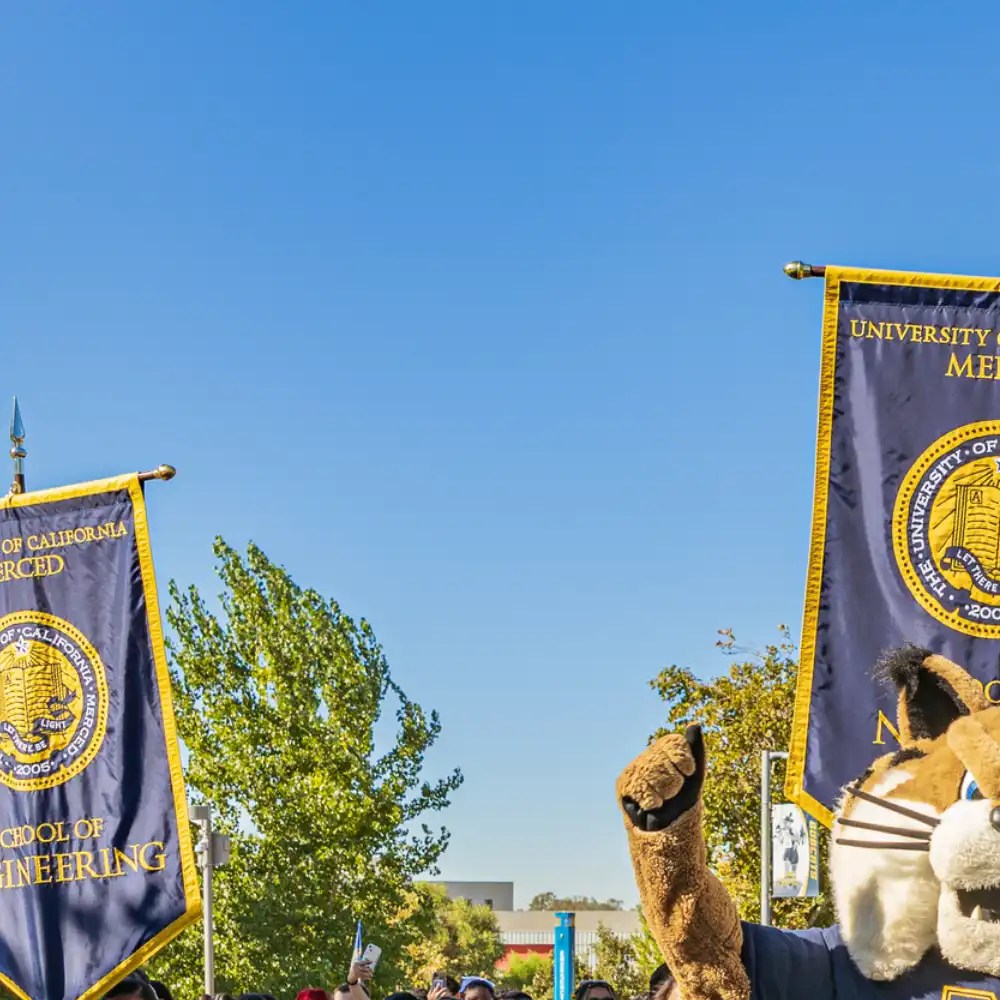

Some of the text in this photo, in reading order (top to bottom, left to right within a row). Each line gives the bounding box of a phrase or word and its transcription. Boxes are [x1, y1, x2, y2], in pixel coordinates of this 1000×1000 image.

[850, 319, 992, 347] UNIVERSITY
[972, 439, 998, 455] OF
[910, 448, 966, 554] UNIVERSITY
[2, 521, 129, 554] OF CALIFORNIA
[0, 554, 64, 582] RCED
[918, 559, 947, 598] THE
[956, 549, 975, 567] LET
[973, 562, 997, 593] THERE
[21, 626, 94, 686] CALIFORNIA
[67, 693, 97, 756] MERCED
[16, 763, 51, 776] 2005
[0, 817, 104, 849] CHOOL OF
[0, 841, 167, 889] INEERING
